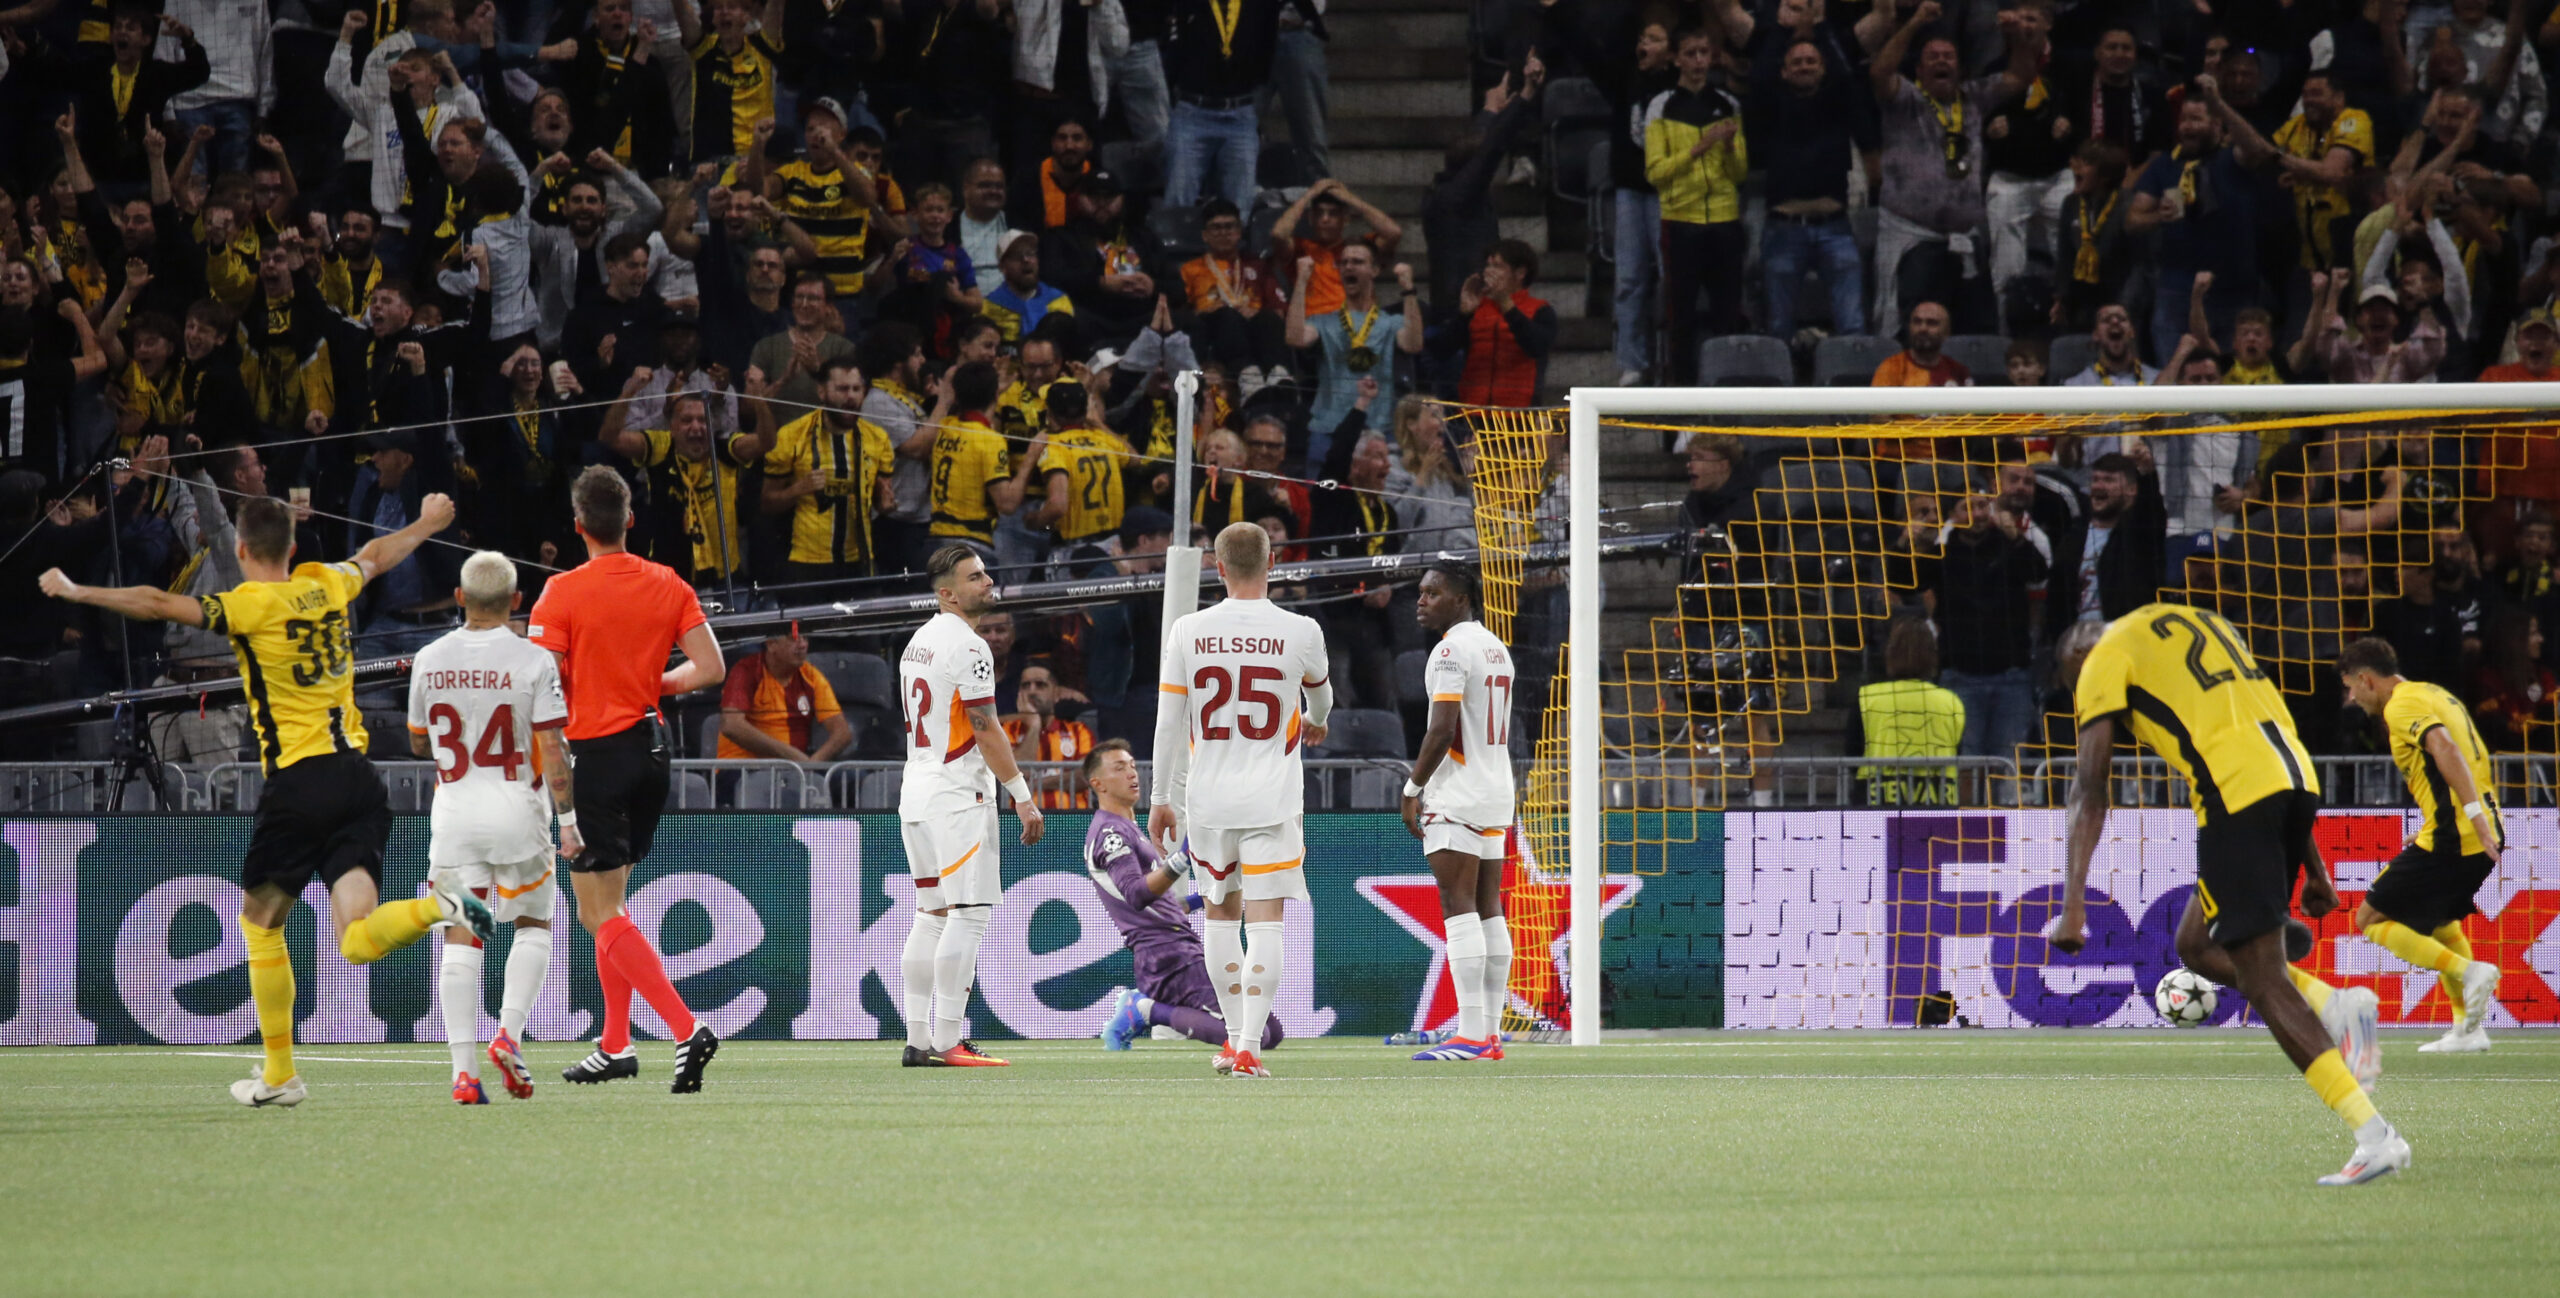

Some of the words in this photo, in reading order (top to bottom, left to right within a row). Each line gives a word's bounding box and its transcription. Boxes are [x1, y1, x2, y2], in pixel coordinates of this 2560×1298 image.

[934, 455, 953, 505] 9
[1078, 455, 1111, 511] 27
[1371, 555, 1402, 568] Pixy
[286, 611, 350, 687] 30
[1195, 637, 1285, 656] NELSSON
[2151, 611, 2268, 692] 20
[425, 670, 513, 691] TORREIRA
[1194, 665, 1287, 741] 25
[1484, 674, 1511, 746] 17
[429, 702, 525, 784] 34
